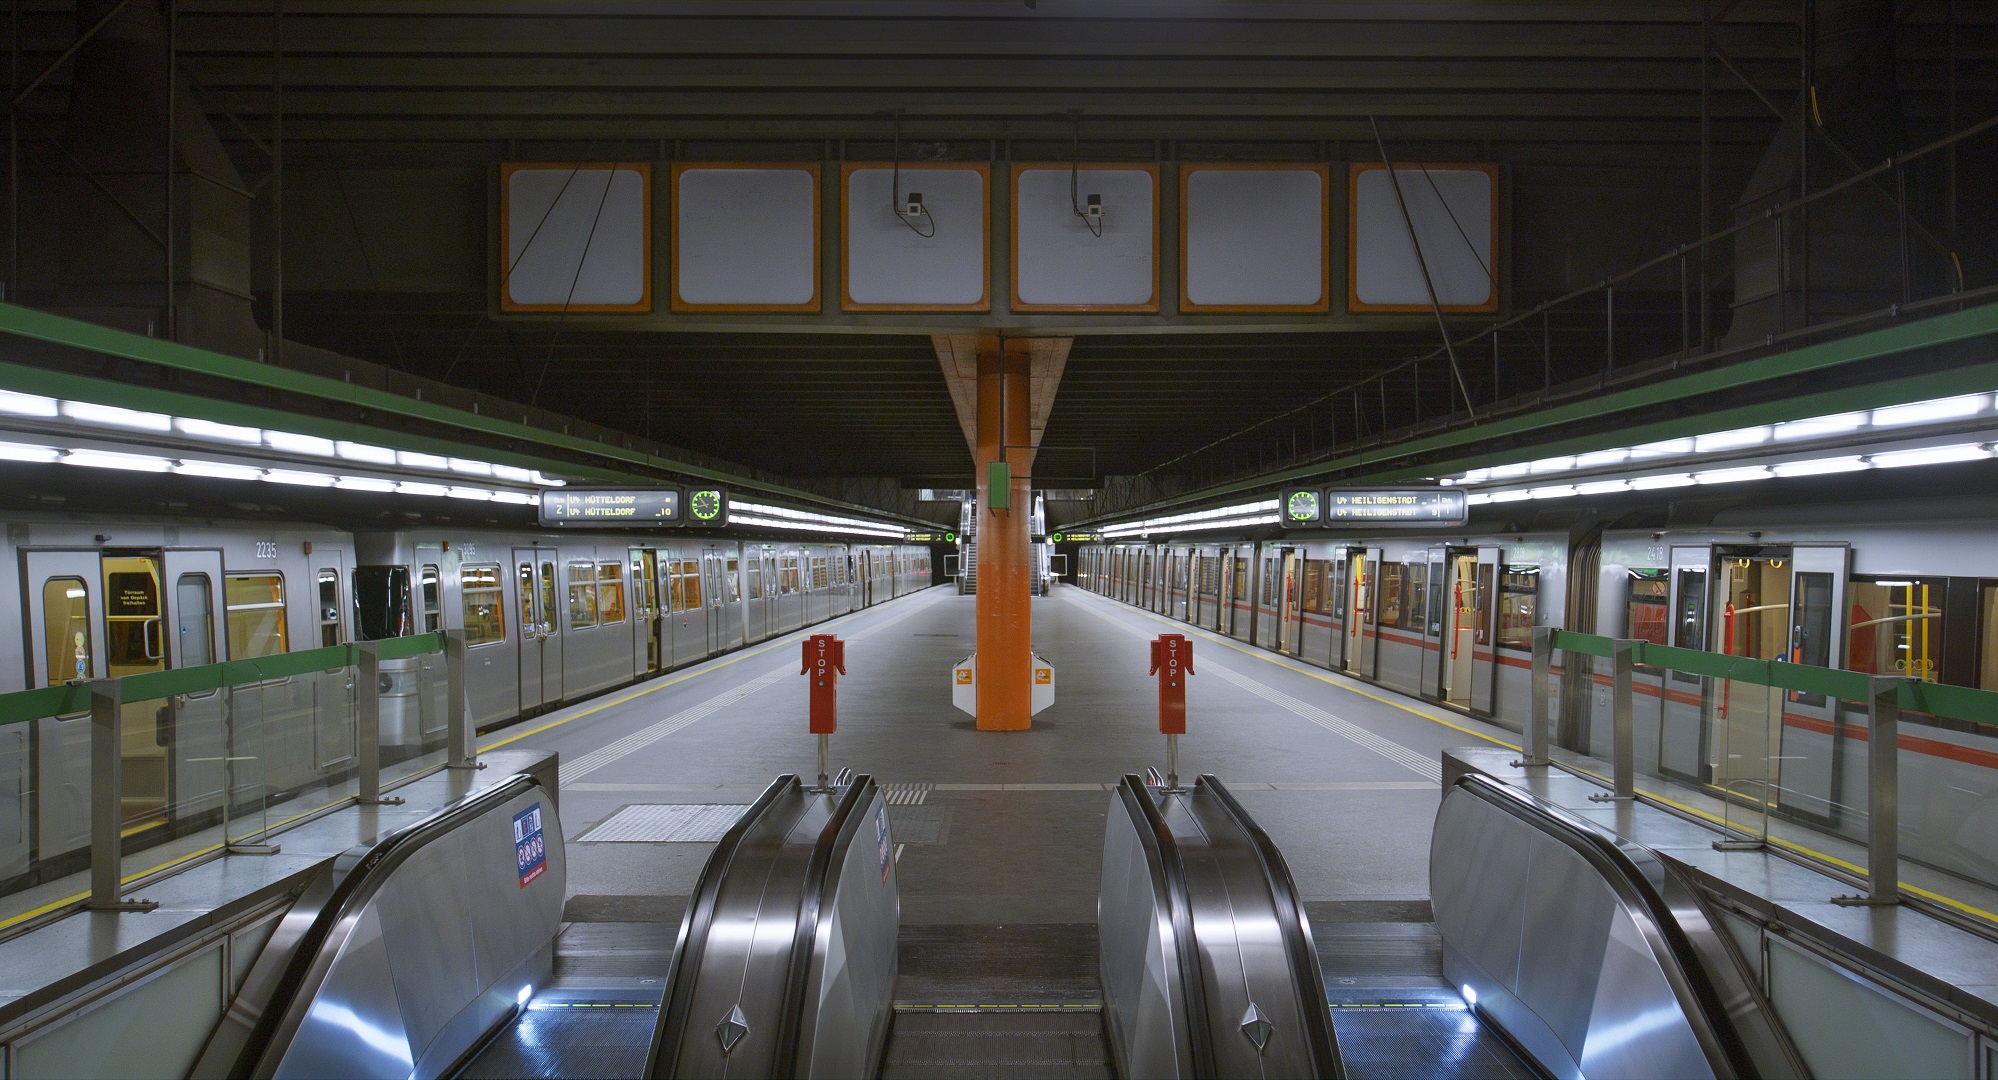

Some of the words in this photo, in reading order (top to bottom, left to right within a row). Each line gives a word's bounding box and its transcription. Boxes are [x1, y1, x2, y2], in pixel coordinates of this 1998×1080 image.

[584, 495, 636, 504] HÜTTELDORF
[1336, 496, 1347, 504] U4
[1351, 496, 1417, 504] HEILIGENSTADT
[556, 504, 563, 515] 2
[584, 507, 636, 516] HÜTTELDORF
[1336, 508, 1347, 516] U4
[1351, 508, 1417, 516] HEILIGENSTADT
[256, 541, 277, 559] 2235
[1647, 546, 1664, 561] 2418
[817, 639, 826, 676] STOP
[1169, 639, 1178, 676] STOP
